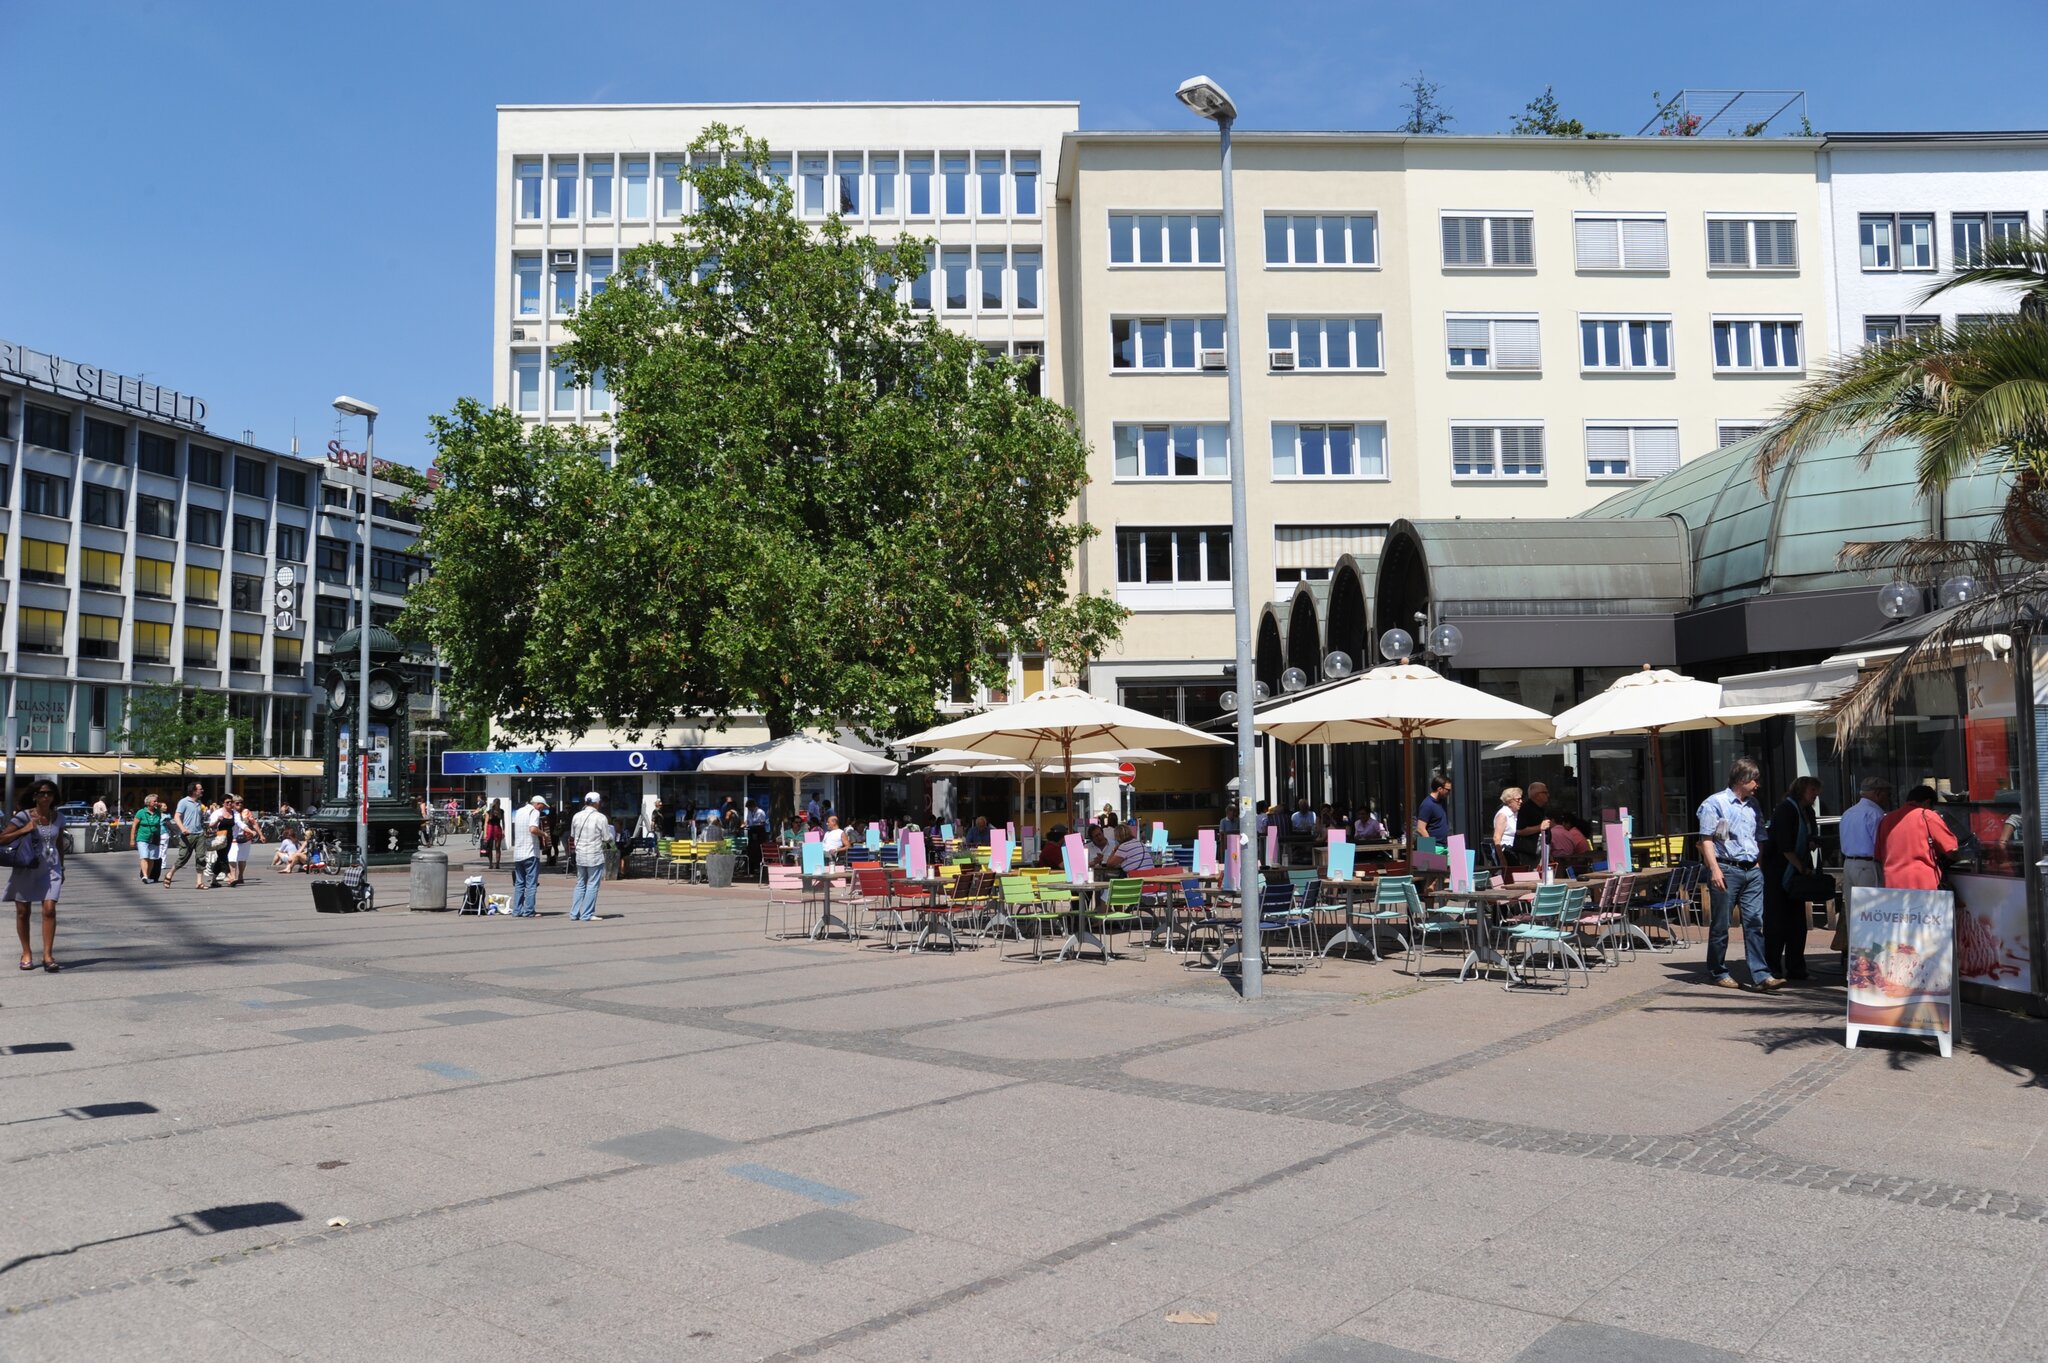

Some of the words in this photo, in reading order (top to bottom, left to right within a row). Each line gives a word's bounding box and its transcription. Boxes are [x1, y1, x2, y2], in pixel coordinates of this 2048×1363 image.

[76, 363, 208, 423] SEEFELD
[16, 700, 65, 712] KLASSIK
[32, 714, 65, 723] FOLK
[628, 751, 648, 770] O2
[1860, 909, 1941, 926] MÖVENPICK
